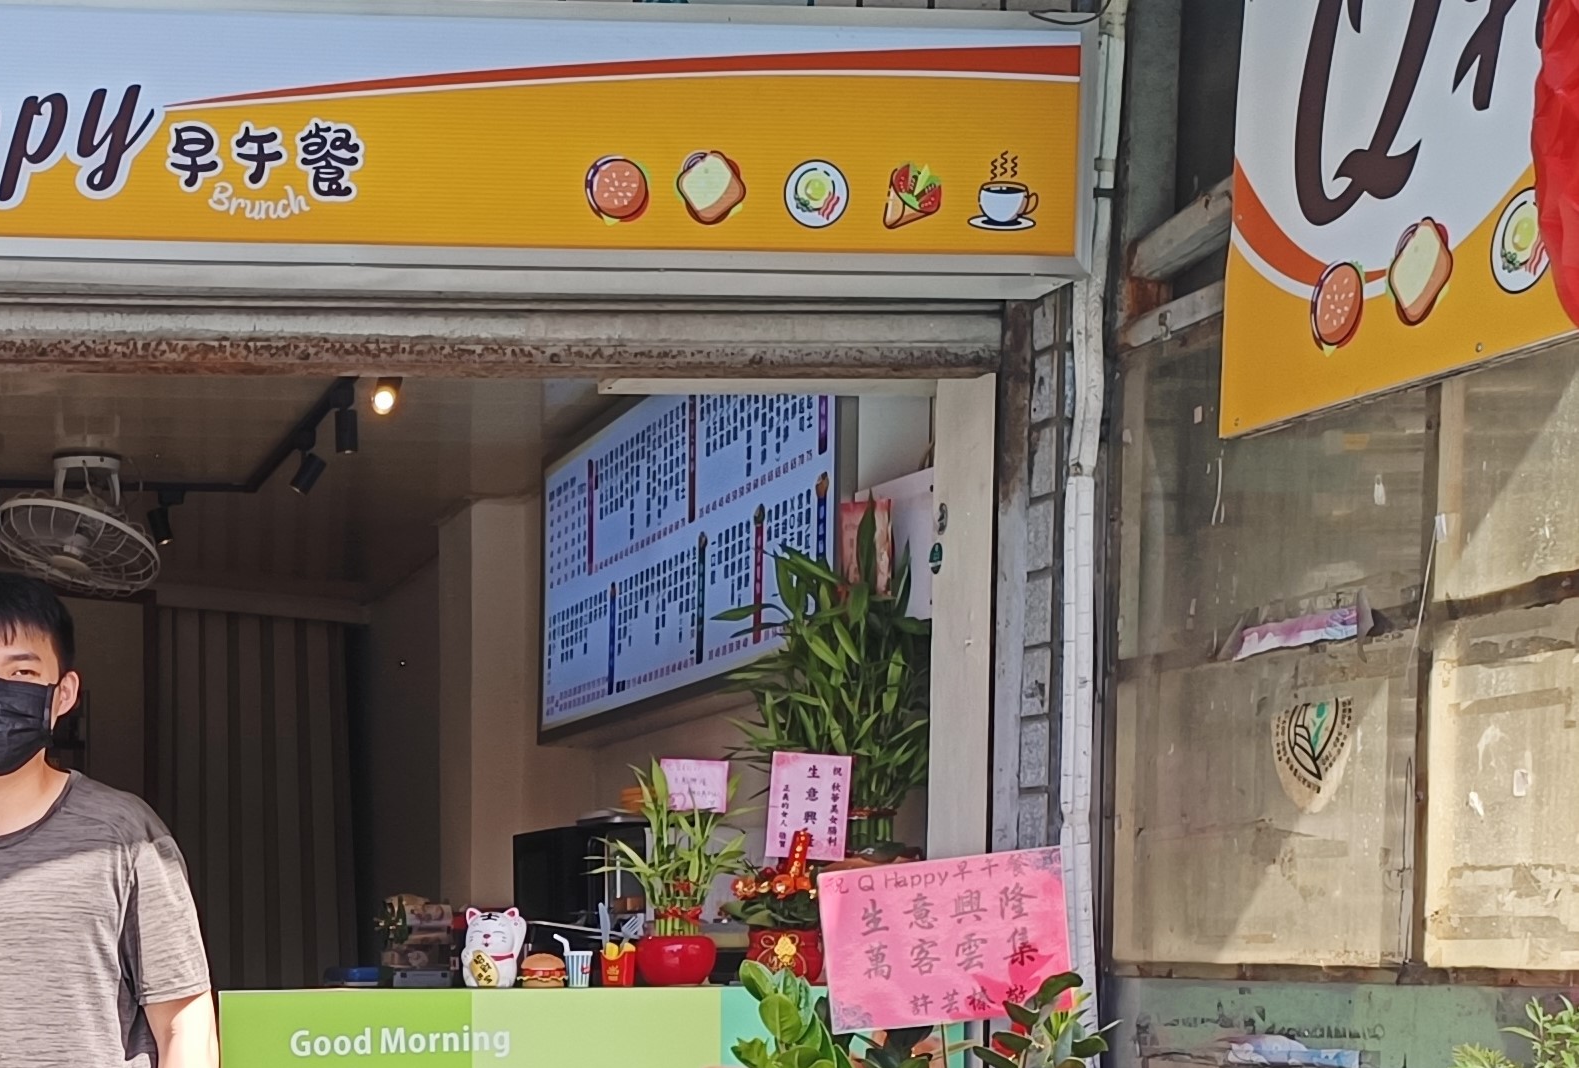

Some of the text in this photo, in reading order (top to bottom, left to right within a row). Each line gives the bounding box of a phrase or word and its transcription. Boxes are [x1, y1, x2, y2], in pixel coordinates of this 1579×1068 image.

[170, 122, 360, 197] 早午餐
[208, 181, 310, 219] Brunch
[884, 871, 949, 889] Happy
[860, 882, 1038, 937] 生意興隆
[863, 926, 1039, 981] 萬客雲集
[290, 1024, 510, 1058] Good Morning
